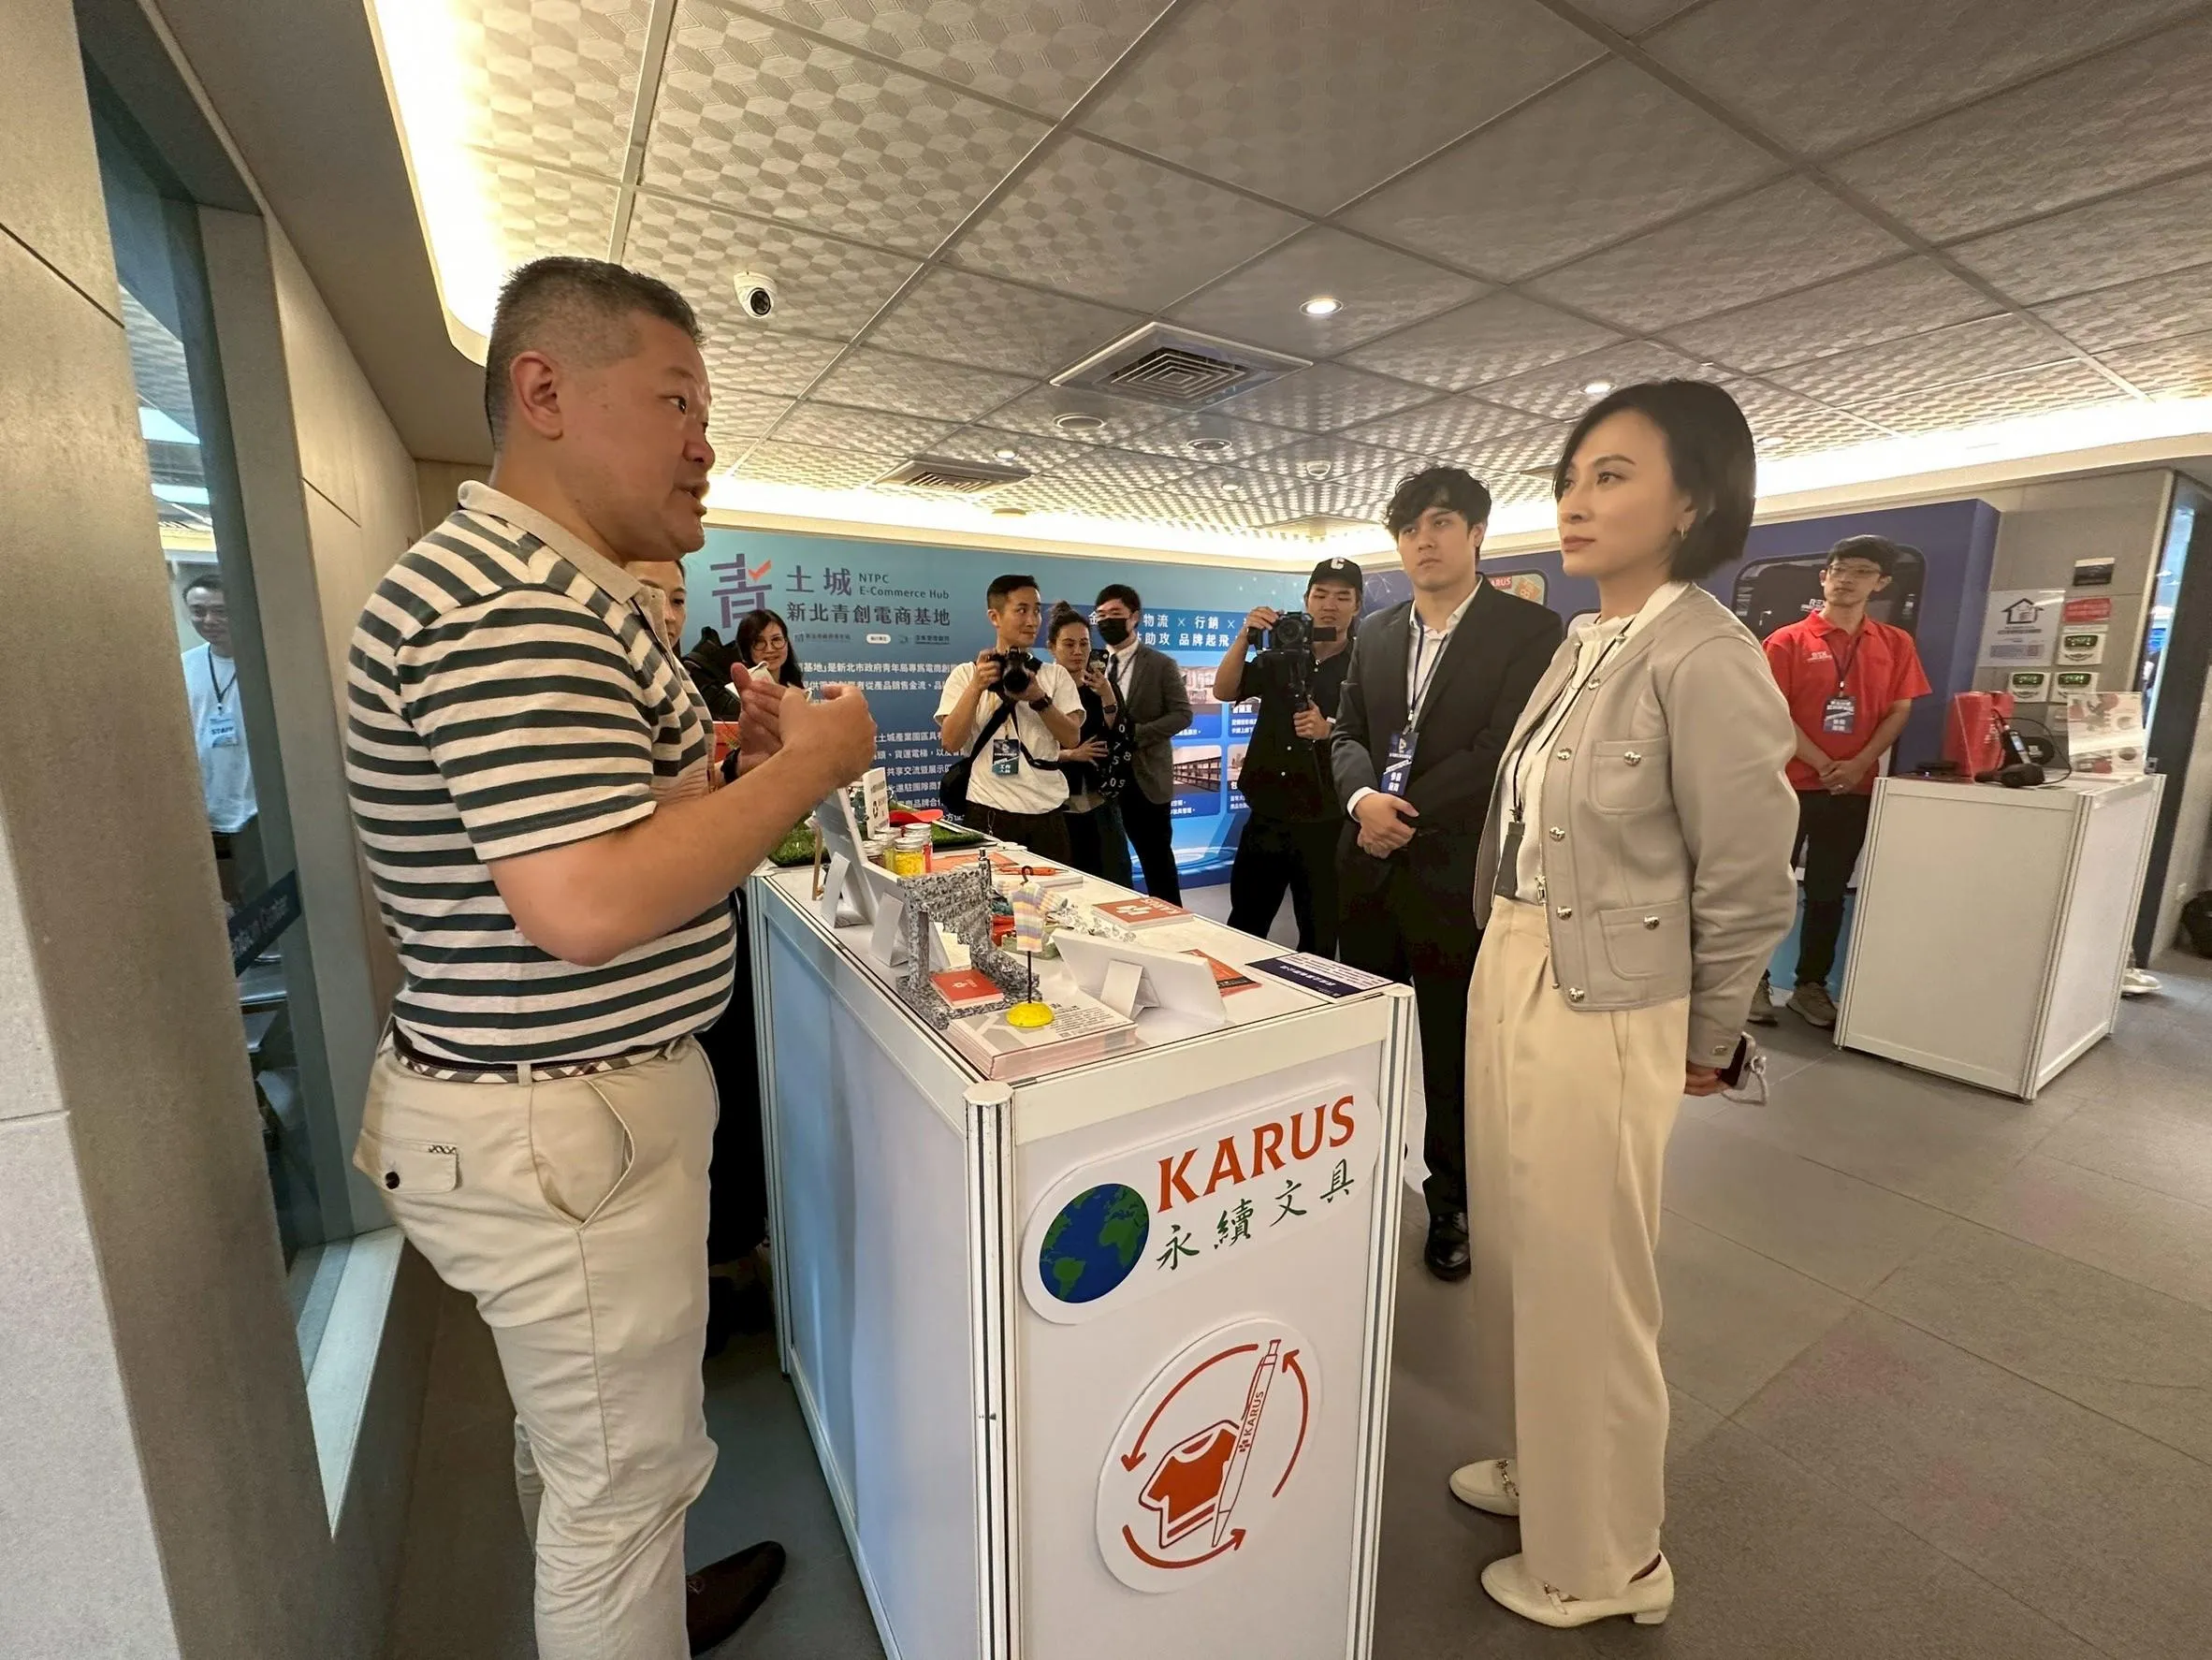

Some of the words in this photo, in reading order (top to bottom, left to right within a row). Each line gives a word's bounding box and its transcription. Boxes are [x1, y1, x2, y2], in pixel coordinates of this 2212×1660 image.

[786, 565, 852, 596] 土城
[859, 574, 889, 584] NTPC
[1491, 577, 1511, 587] ARUS
[860, 587, 925, 598] E-Commerce
[929, 590, 950, 599] Hub
[787, 602, 951, 626] 新北青創電商基地
[1143, 614, 1169, 628] 物流
[1194, 616, 1219, 630] 行銷
[1179, 633, 1230, 647] 品牌起飛
[1157, 1095, 1355, 1214] KARUS
[1157, 1158, 1355, 1272] 永續文具
[1244, 1391, 1264, 1436] KARUS
